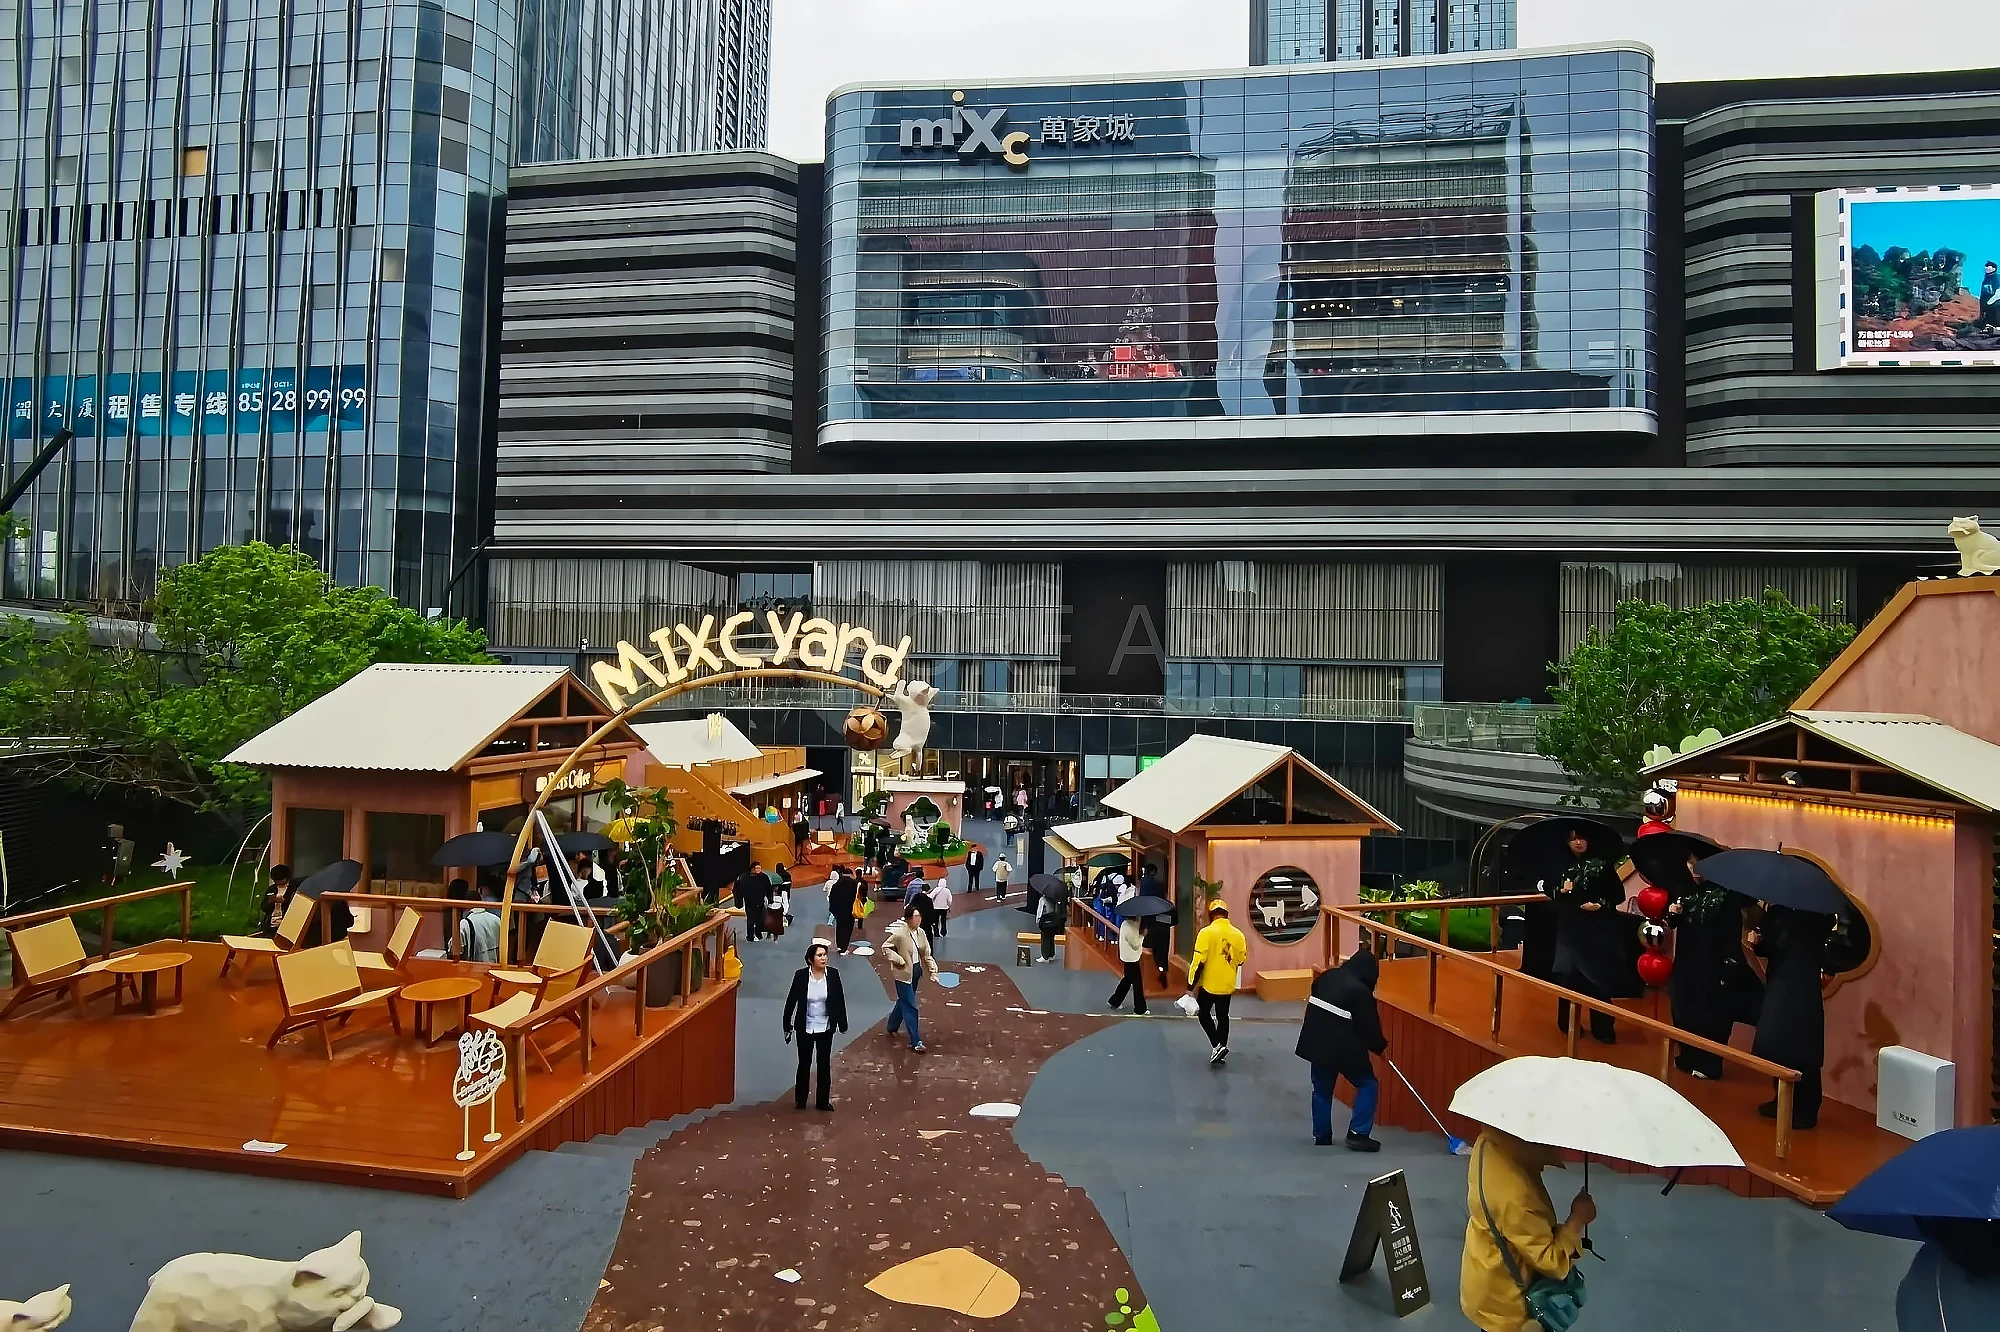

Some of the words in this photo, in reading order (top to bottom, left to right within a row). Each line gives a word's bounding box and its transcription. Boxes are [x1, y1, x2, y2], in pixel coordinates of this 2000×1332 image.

[1040, 112, 1136, 143] 萬象城
[108, 392, 227, 418] 租售专线
[569, 768, 591, 789] Coffee
